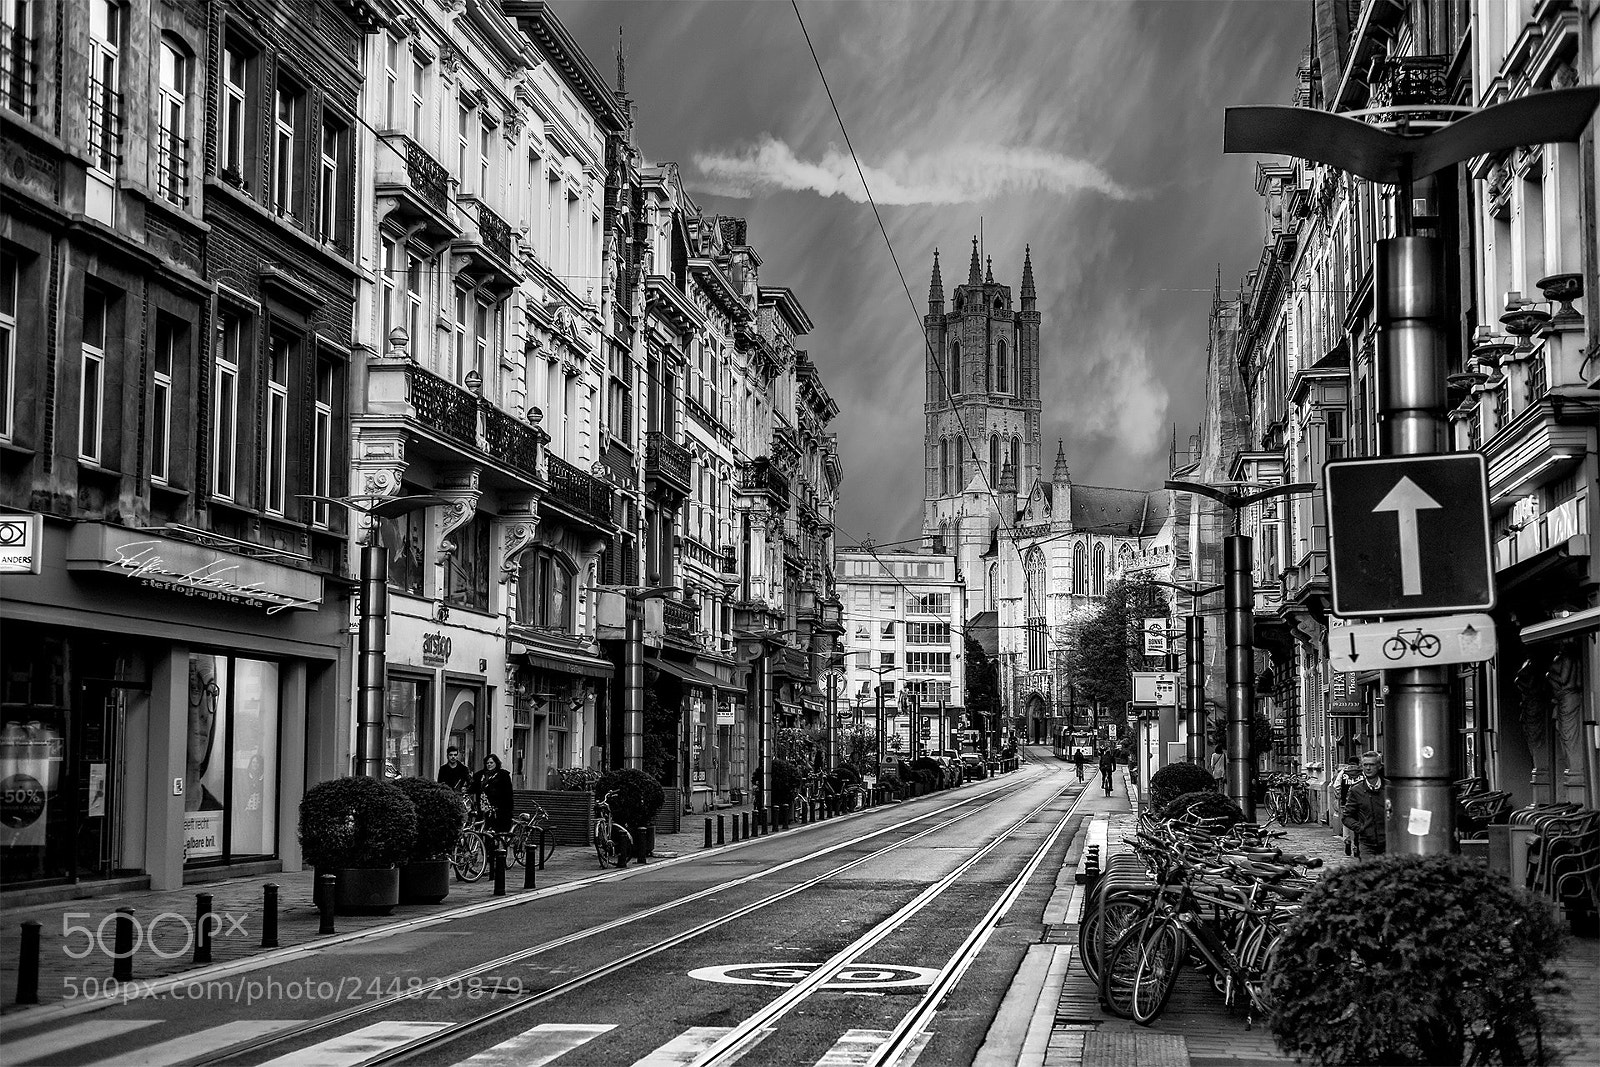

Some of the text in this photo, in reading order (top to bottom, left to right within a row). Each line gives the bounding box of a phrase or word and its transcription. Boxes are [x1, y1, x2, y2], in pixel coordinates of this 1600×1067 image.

[922, 716, 929, 725] P
[0, 789, 40, 804] -50%
[183, 817, 209, 831] eeft recht
